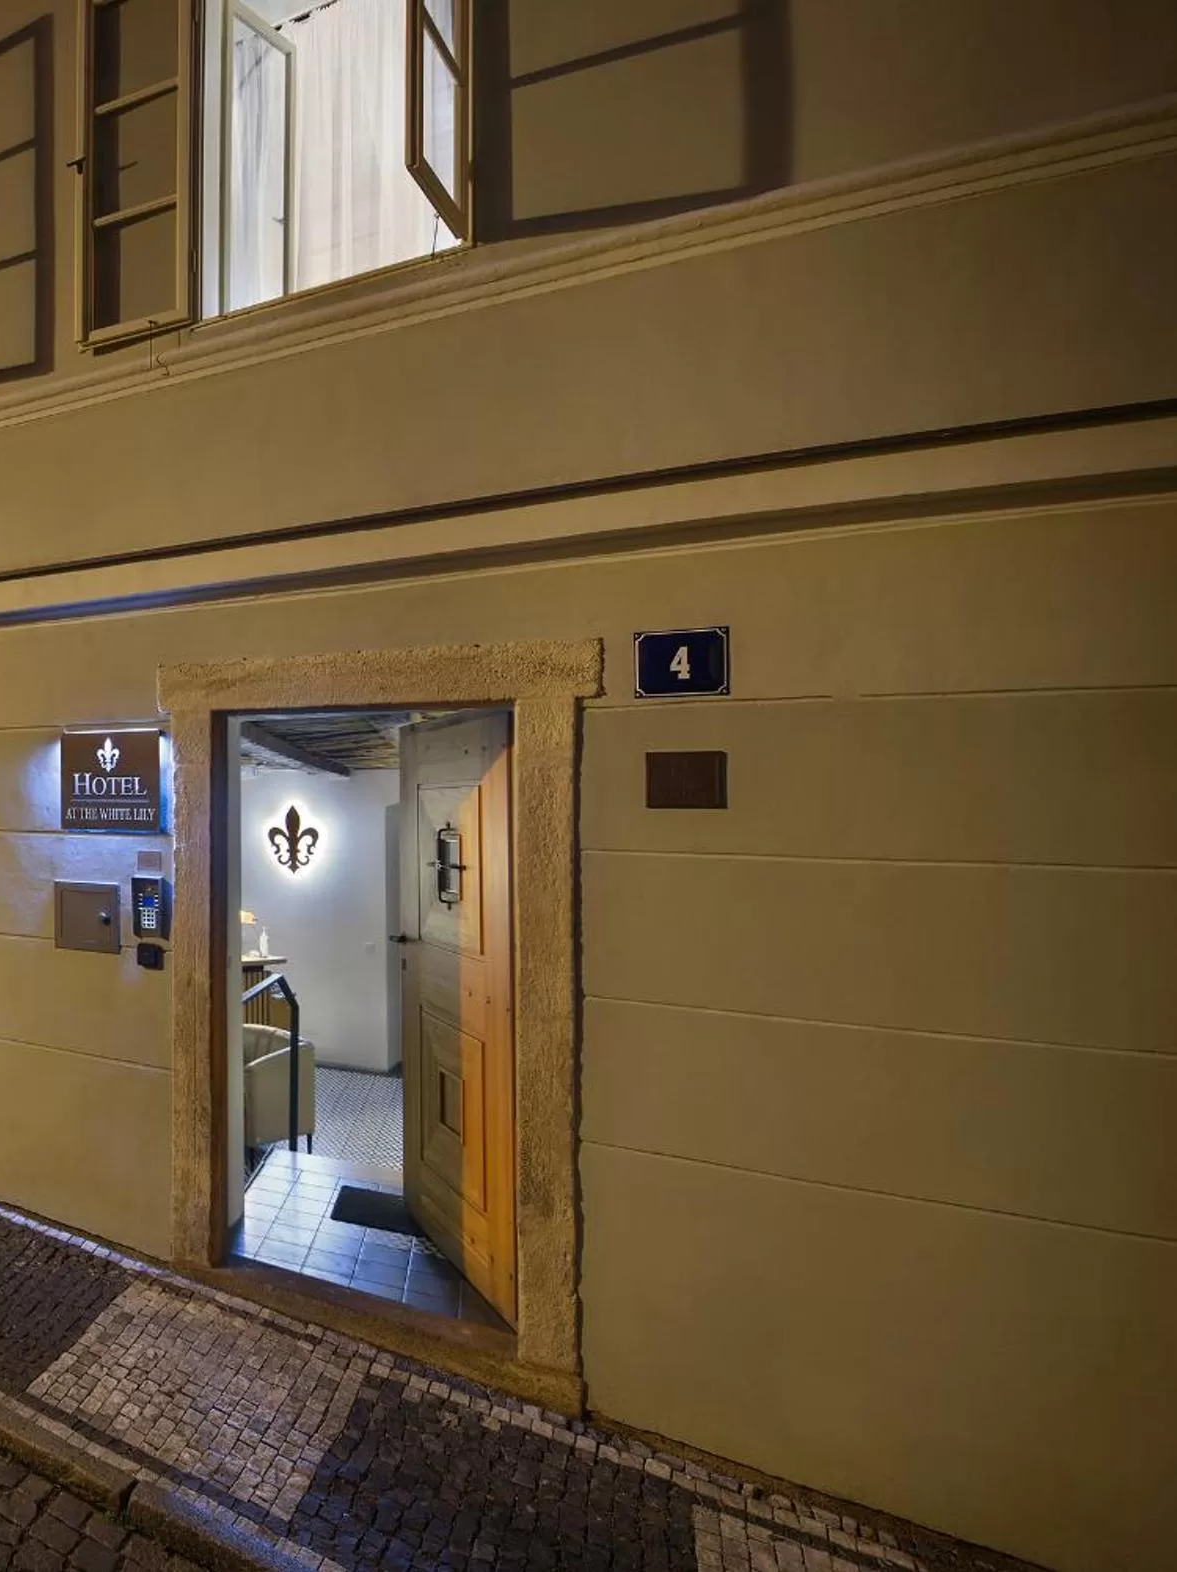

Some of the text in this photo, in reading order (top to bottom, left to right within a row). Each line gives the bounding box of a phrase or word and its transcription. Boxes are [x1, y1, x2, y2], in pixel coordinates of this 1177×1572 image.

[669, 646, 691, 680] 4
[72, 772, 148, 796] HOTEL
[65, 807, 156, 821] AT THE WHITE LILY
